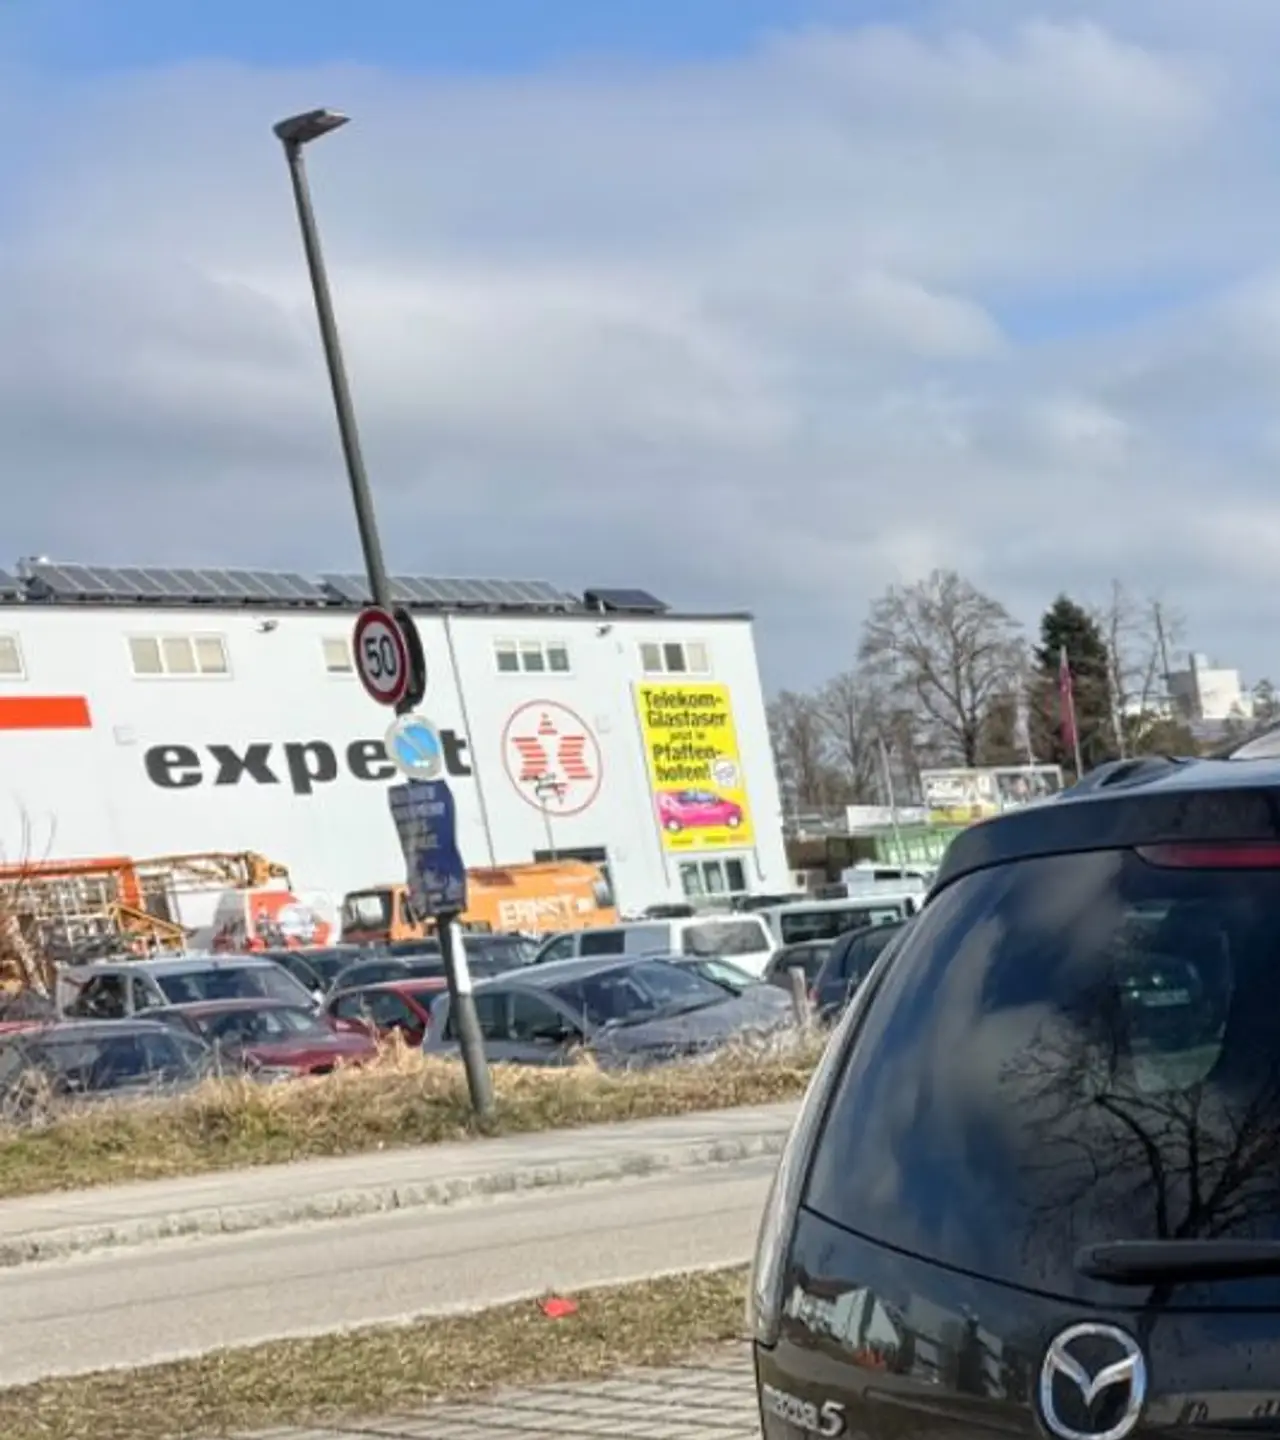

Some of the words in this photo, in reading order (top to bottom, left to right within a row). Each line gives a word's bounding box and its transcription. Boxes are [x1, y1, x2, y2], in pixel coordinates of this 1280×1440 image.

[365, 635, 396, 680] 50
[641, 690, 724, 709] Telekom-
[647, 710, 727, 728] Glasfaser
[143, 729, 472, 795] expet
[652, 743, 723, 762] Pfaffen-
